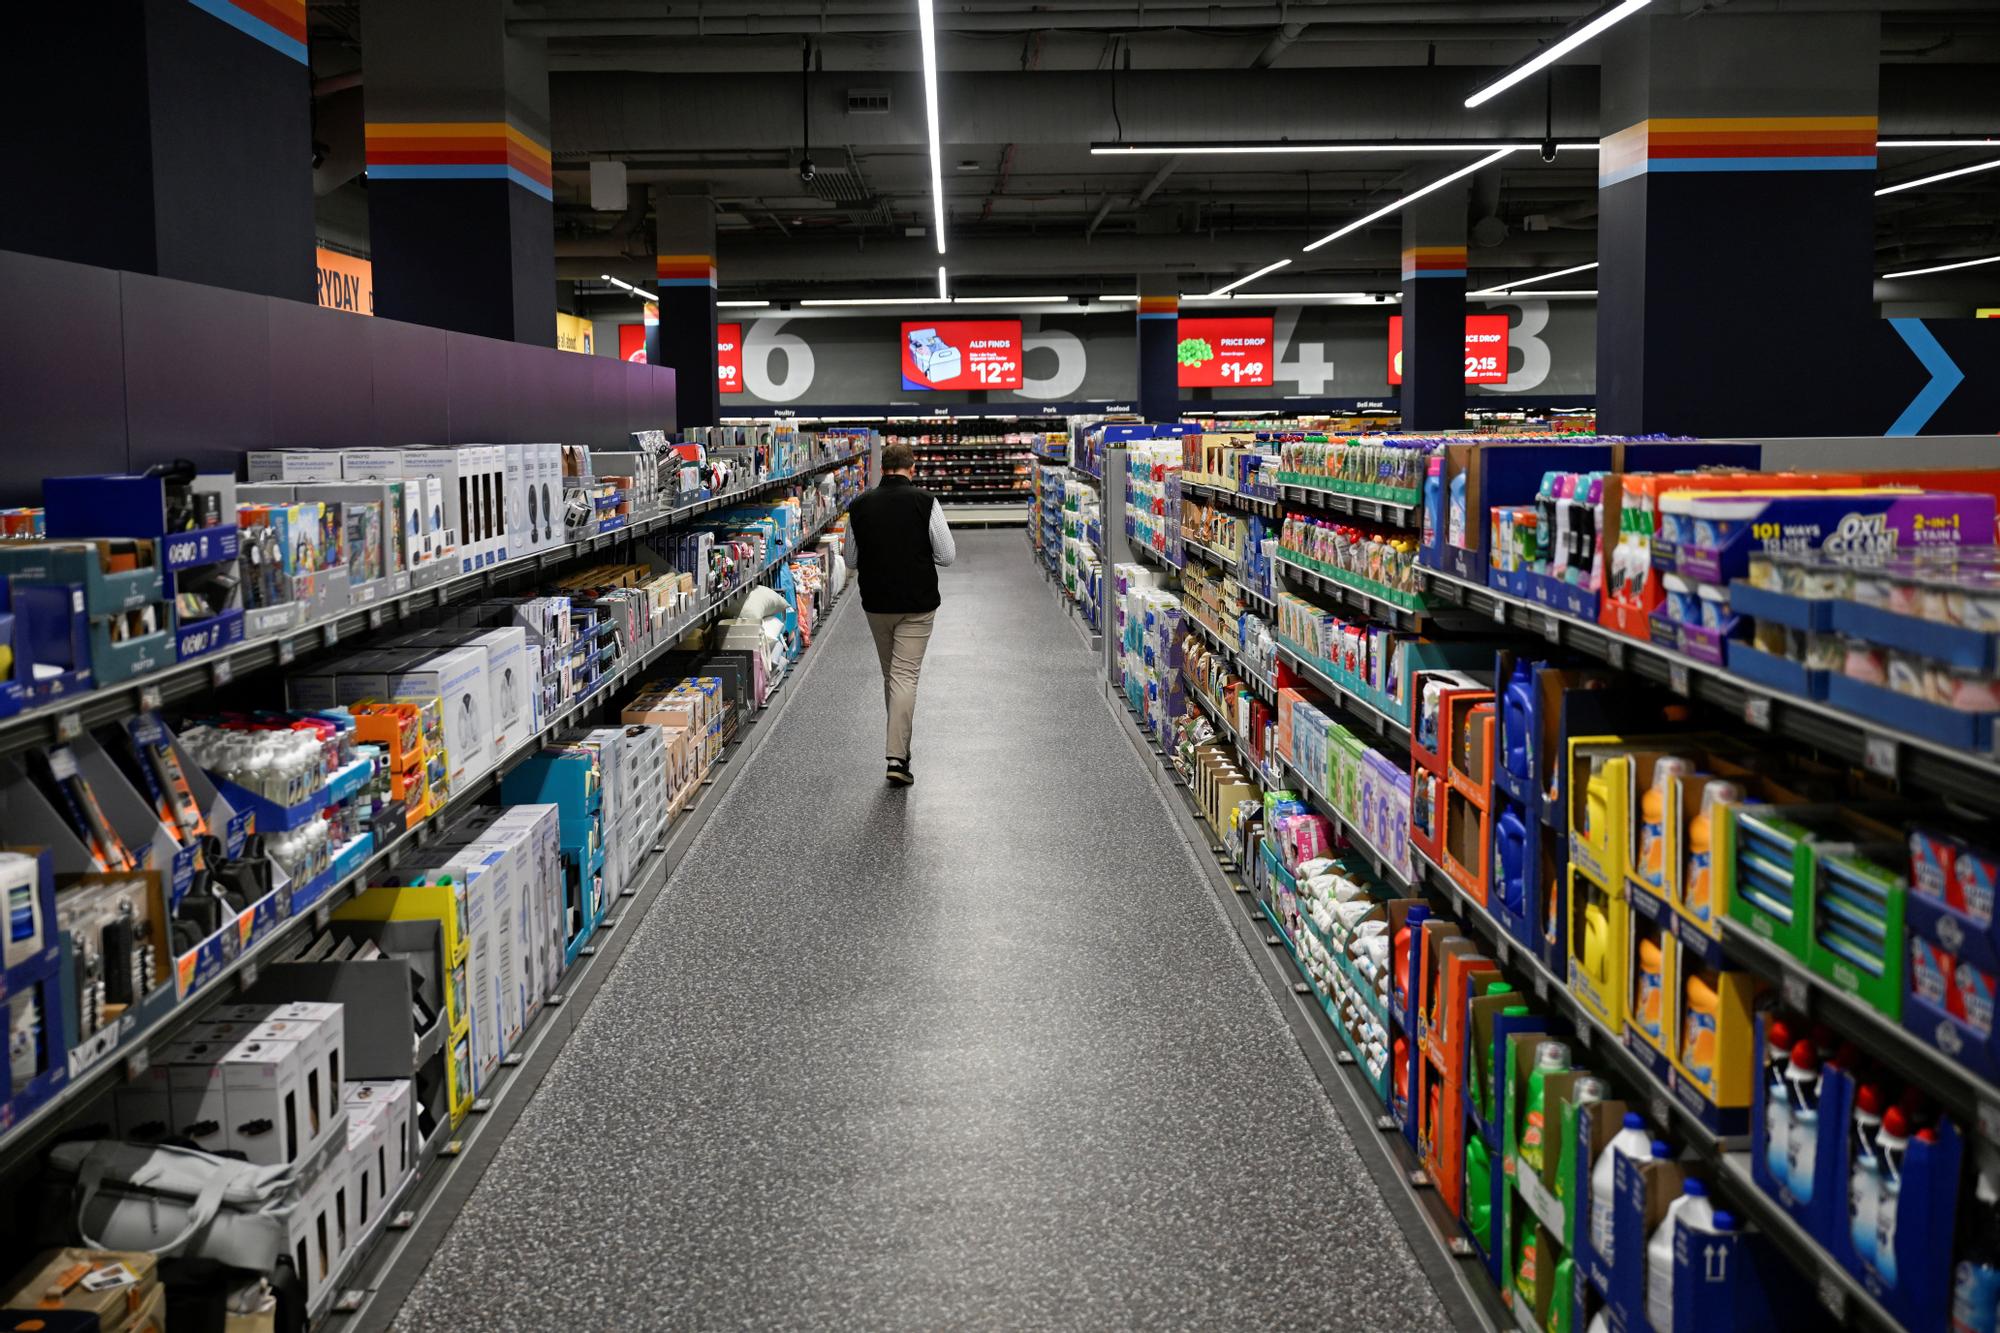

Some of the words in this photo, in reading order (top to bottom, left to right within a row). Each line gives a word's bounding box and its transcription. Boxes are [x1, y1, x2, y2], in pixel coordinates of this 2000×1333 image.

[969, 340, 986, 349] ALDI
[988, 340, 1011, 348] FINDS
[1220, 338, 1243, 346] PRICE
[1244, 338, 1265, 346] DROP
[1273, 305, 1334, 395] 4
[1479, 335, 1501, 343] DROP
[1479, 299, 1551, 392] 3
[742, 318, 815, 402] 6
[1012, 329, 1087, 399] 5
[970, 361, 1016, 383] $12.99
[1220, 362, 1264, 384] $1.49
[774, 409, 795, 417] Poultry
[1043, 406, 1057, 414] Pork
[1106, 405, 1130, 413] Seafood
[1752, 523, 1780, 540] 101
[1840, 516, 1882, 541] OXI
[1362, 781, 1372, 829] 6
[1378, 795, 1388, 846] 6
[1394, 810, 1405, 861] 6
